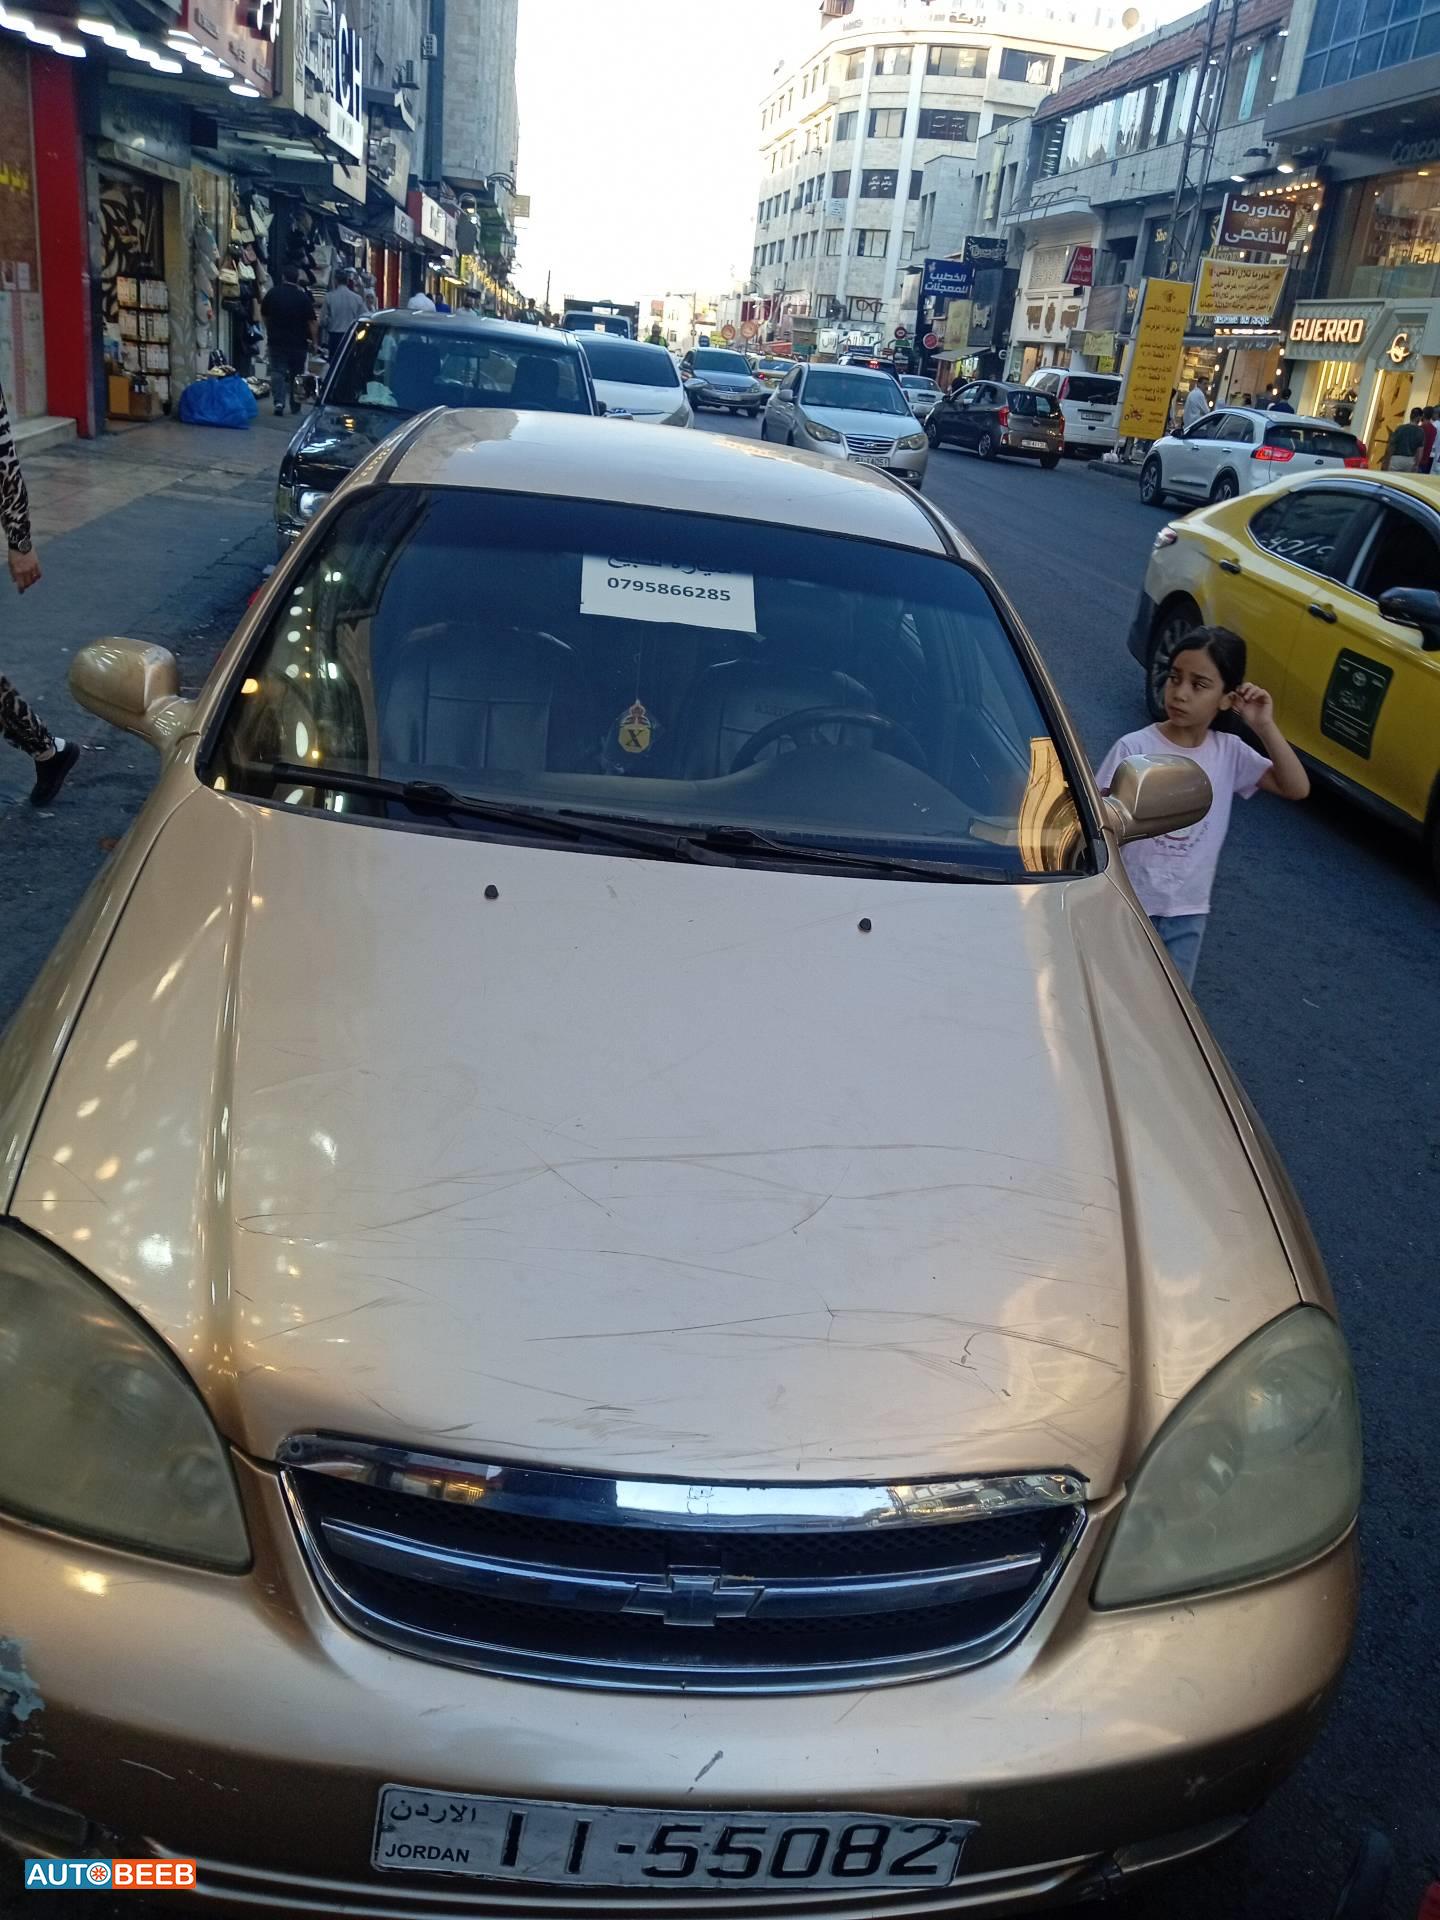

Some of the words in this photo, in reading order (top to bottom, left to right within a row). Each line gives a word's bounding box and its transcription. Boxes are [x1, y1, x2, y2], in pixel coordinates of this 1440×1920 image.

[1232, 200, 1291, 218] شاورما
[1224, 227, 1288, 245] الأقصى
[930, 272, 967, 282] الخطيب
[1289, 318, 1364, 343] GUERRO
[607, 577, 731, 602] 0795866285
[390, 1799, 477, 1823] الاردن
[385, 1843, 470, 1864] JORDAN
